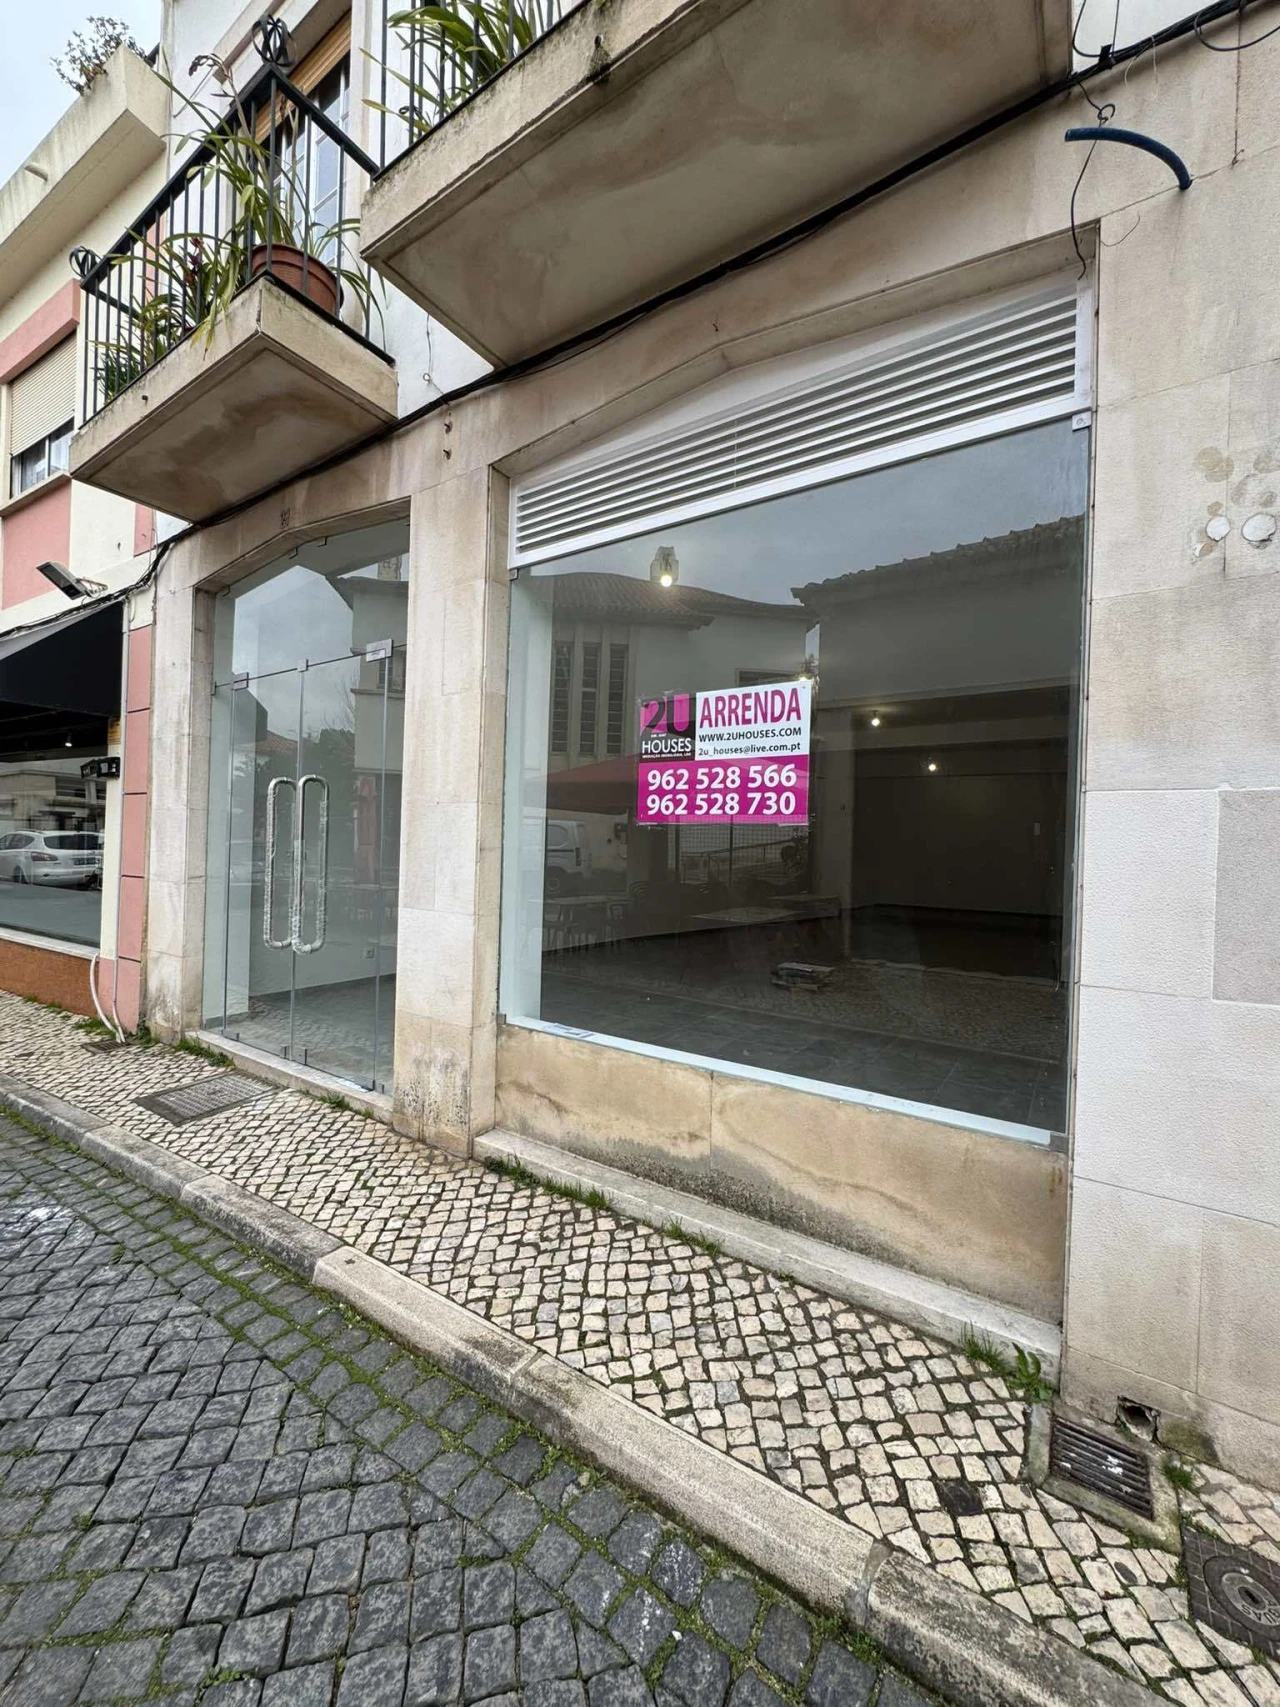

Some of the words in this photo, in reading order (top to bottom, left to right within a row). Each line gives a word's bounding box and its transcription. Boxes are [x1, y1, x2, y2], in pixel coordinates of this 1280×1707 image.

[699, 687, 802, 729] ARRENDA
[641, 737, 692, 754] HOUSES
[698, 727, 802, 743] WWW.2UHOUSES.COM
[698, 742, 801, 757] 2u_houses@live.com.pt
[647, 768, 690, 791] 962
[695, 766, 741, 790] 528
[747, 763, 797, 788] 566
[646, 794, 688, 816] 962
[694, 793, 740, 816] 528
[747, 791, 796, 815] 730
